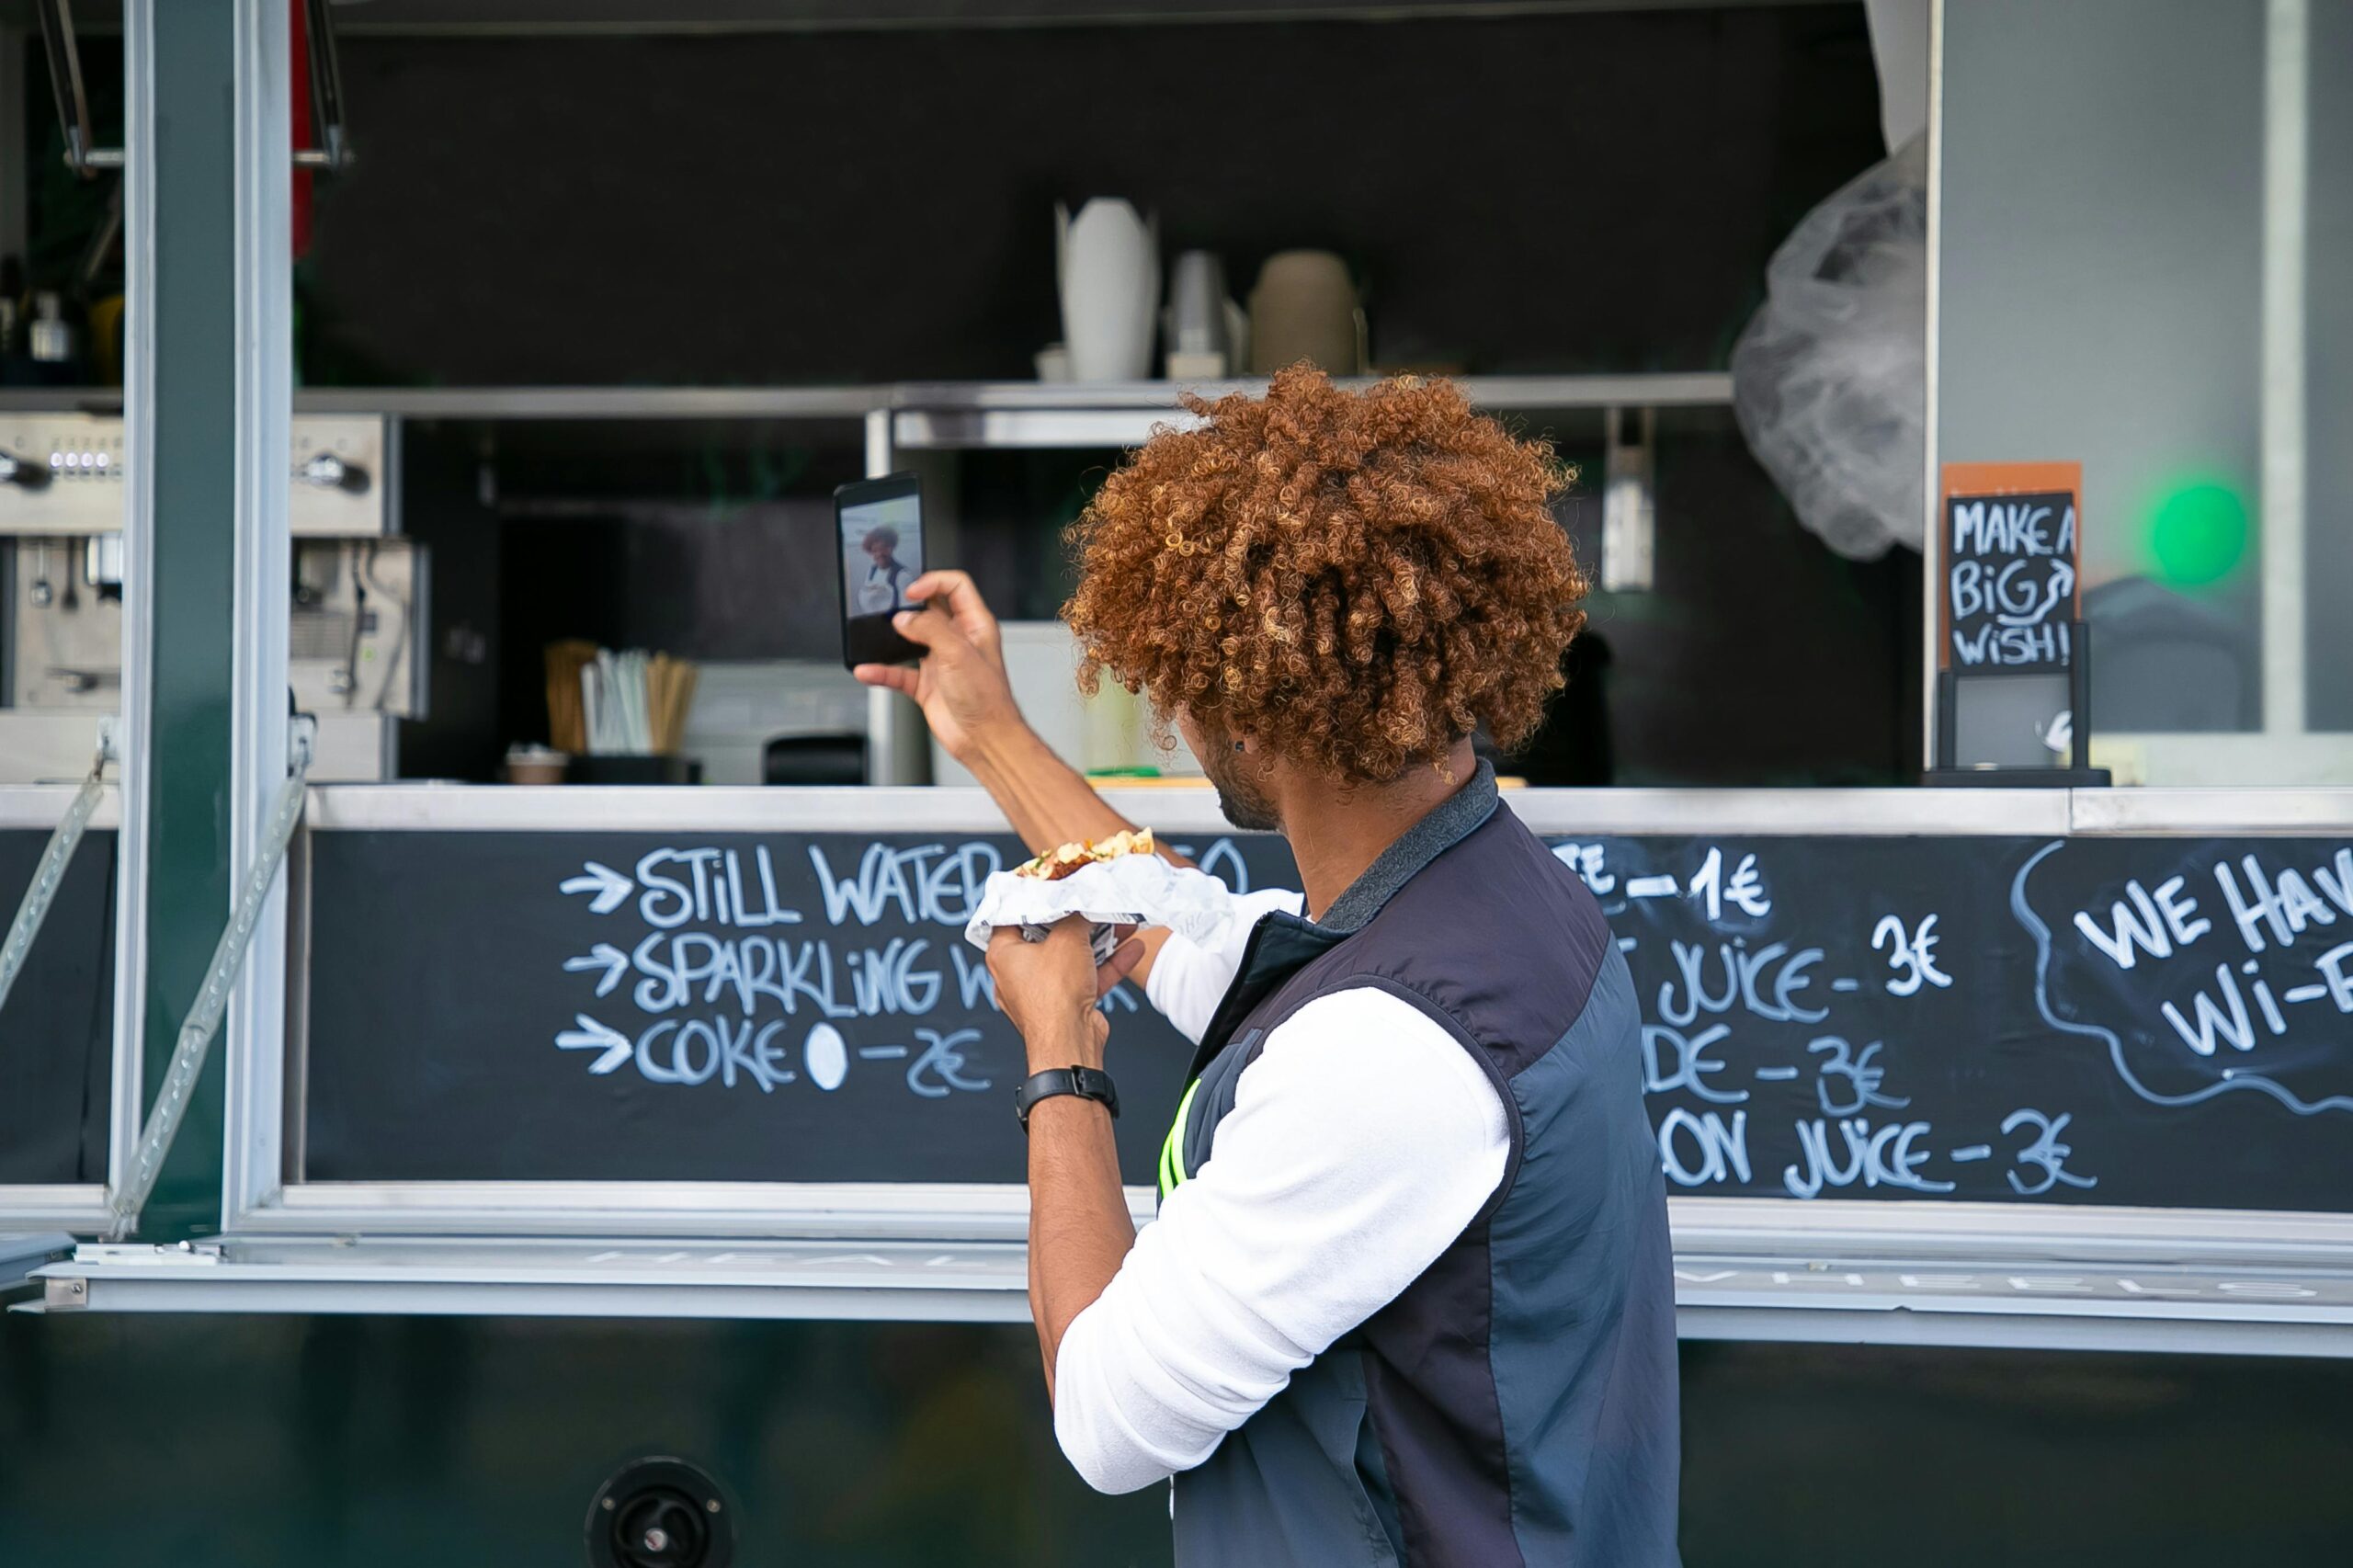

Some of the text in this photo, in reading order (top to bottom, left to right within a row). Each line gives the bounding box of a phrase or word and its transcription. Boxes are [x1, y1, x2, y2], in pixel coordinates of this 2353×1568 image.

[1953, 501, 2053, 555] MAKE
[1871, 913, 1953, 997] 3€
[2074, 875, 2211, 970] WE
[635, 1015, 797, 1094] COKE
